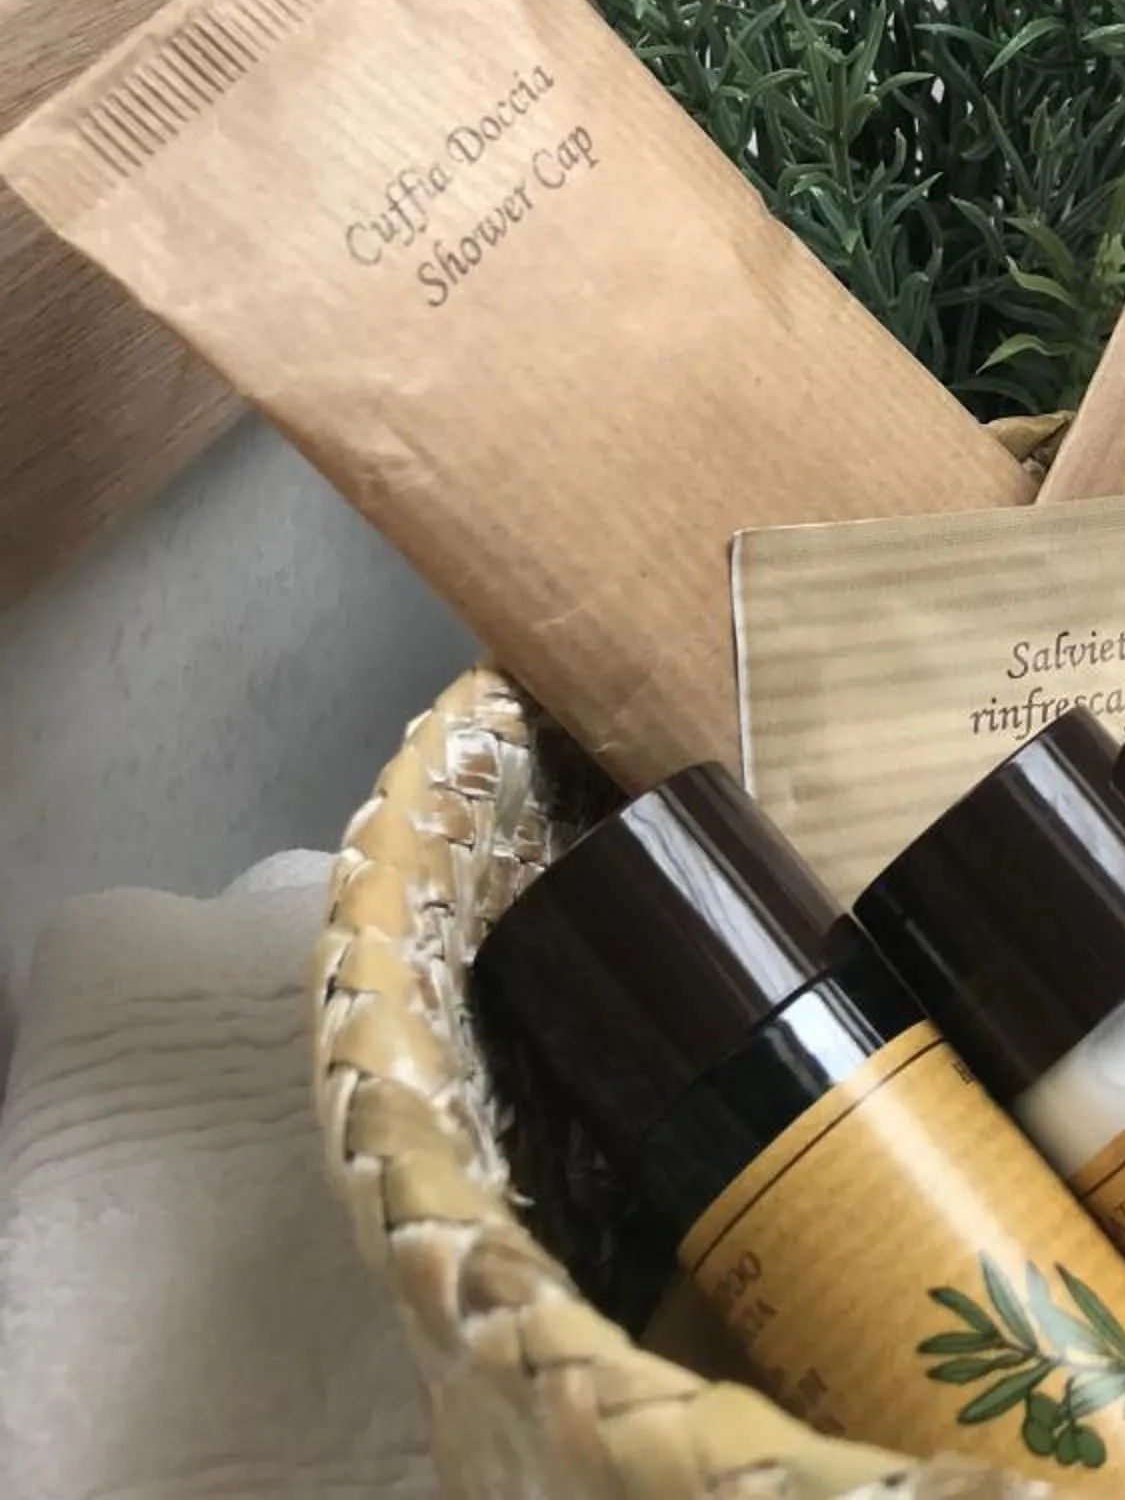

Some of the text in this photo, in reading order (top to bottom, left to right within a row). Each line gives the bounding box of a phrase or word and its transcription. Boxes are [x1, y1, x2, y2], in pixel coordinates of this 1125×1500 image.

[346, 65, 554, 267] Cuffia Doccia
[417, 125, 600, 308] Shower Cap
